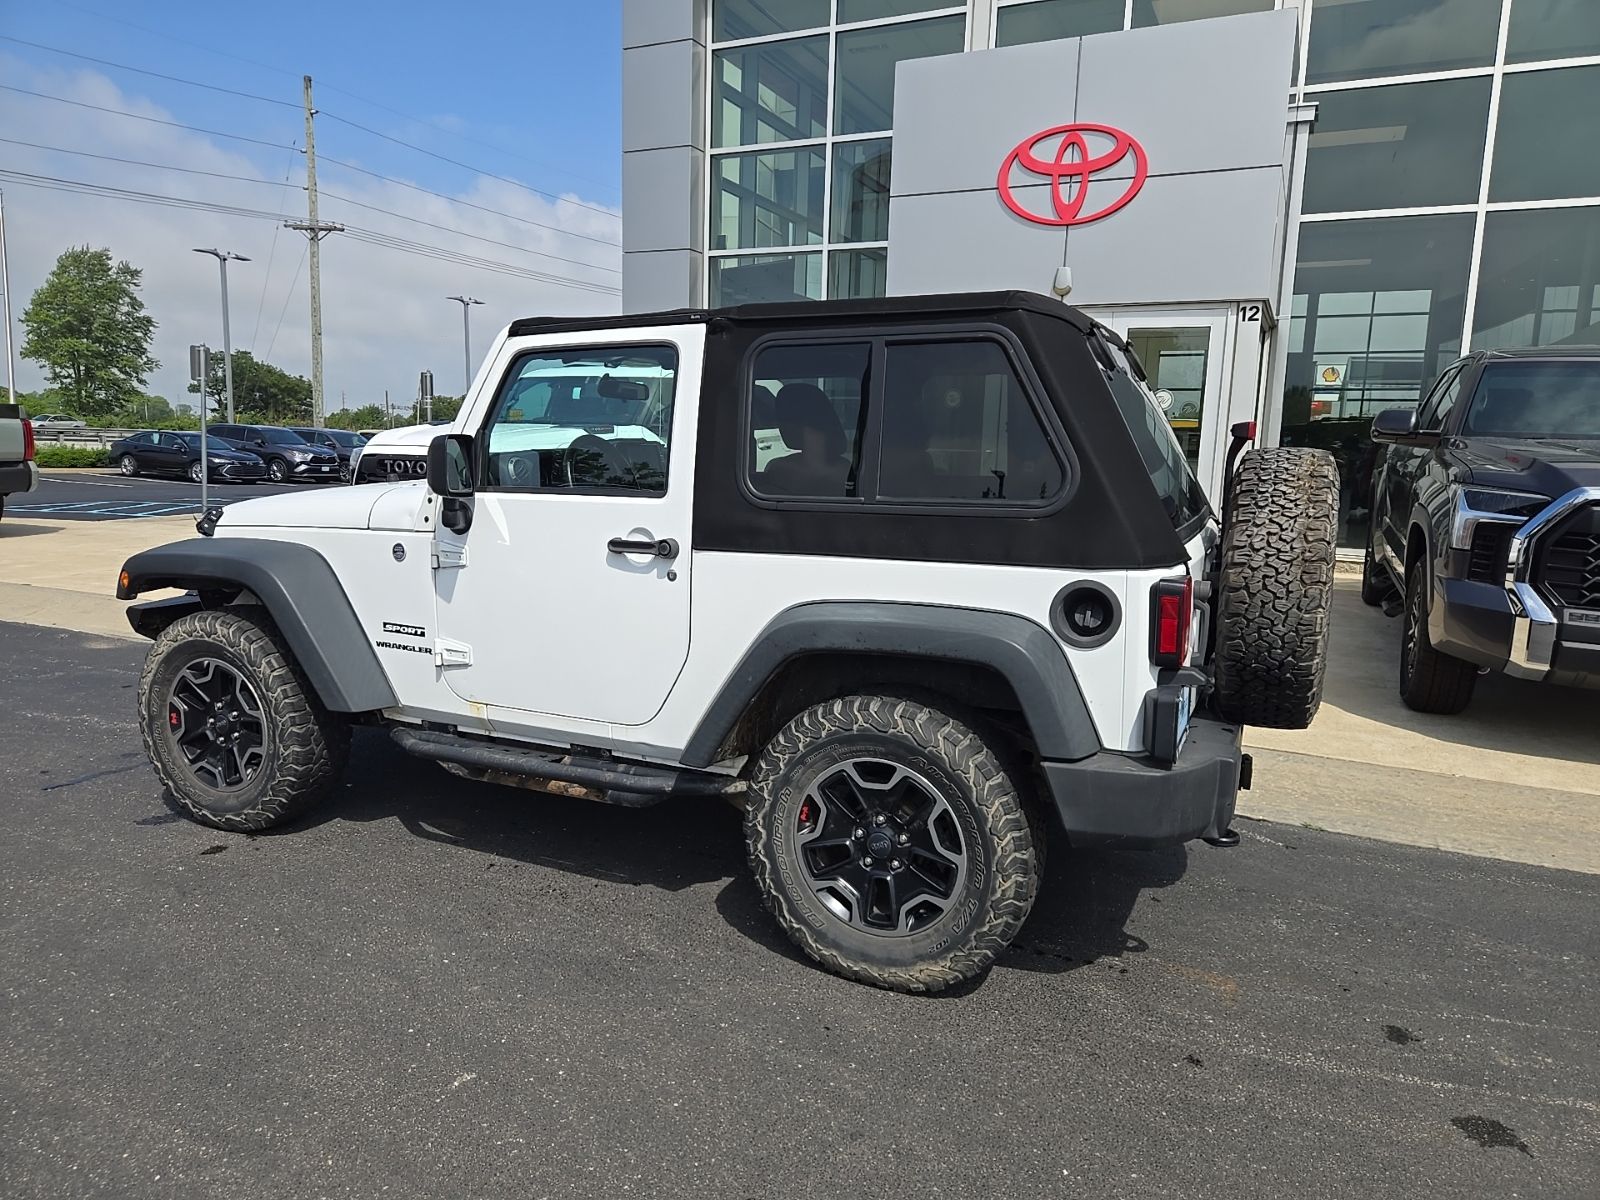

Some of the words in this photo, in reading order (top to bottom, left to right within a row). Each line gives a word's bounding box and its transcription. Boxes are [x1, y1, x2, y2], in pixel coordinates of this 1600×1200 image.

[1240, 305, 1260, 322] 12
[384, 460, 427, 475] TOYO
[383, 624, 424, 636] SPORT
[376, 641, 433, 655] WRANGLER
[911, 756, 986, 889] All-Terrain
[952, 900, 979, 934] T/A
[773, 787, 825, 928] BFGoodrich
